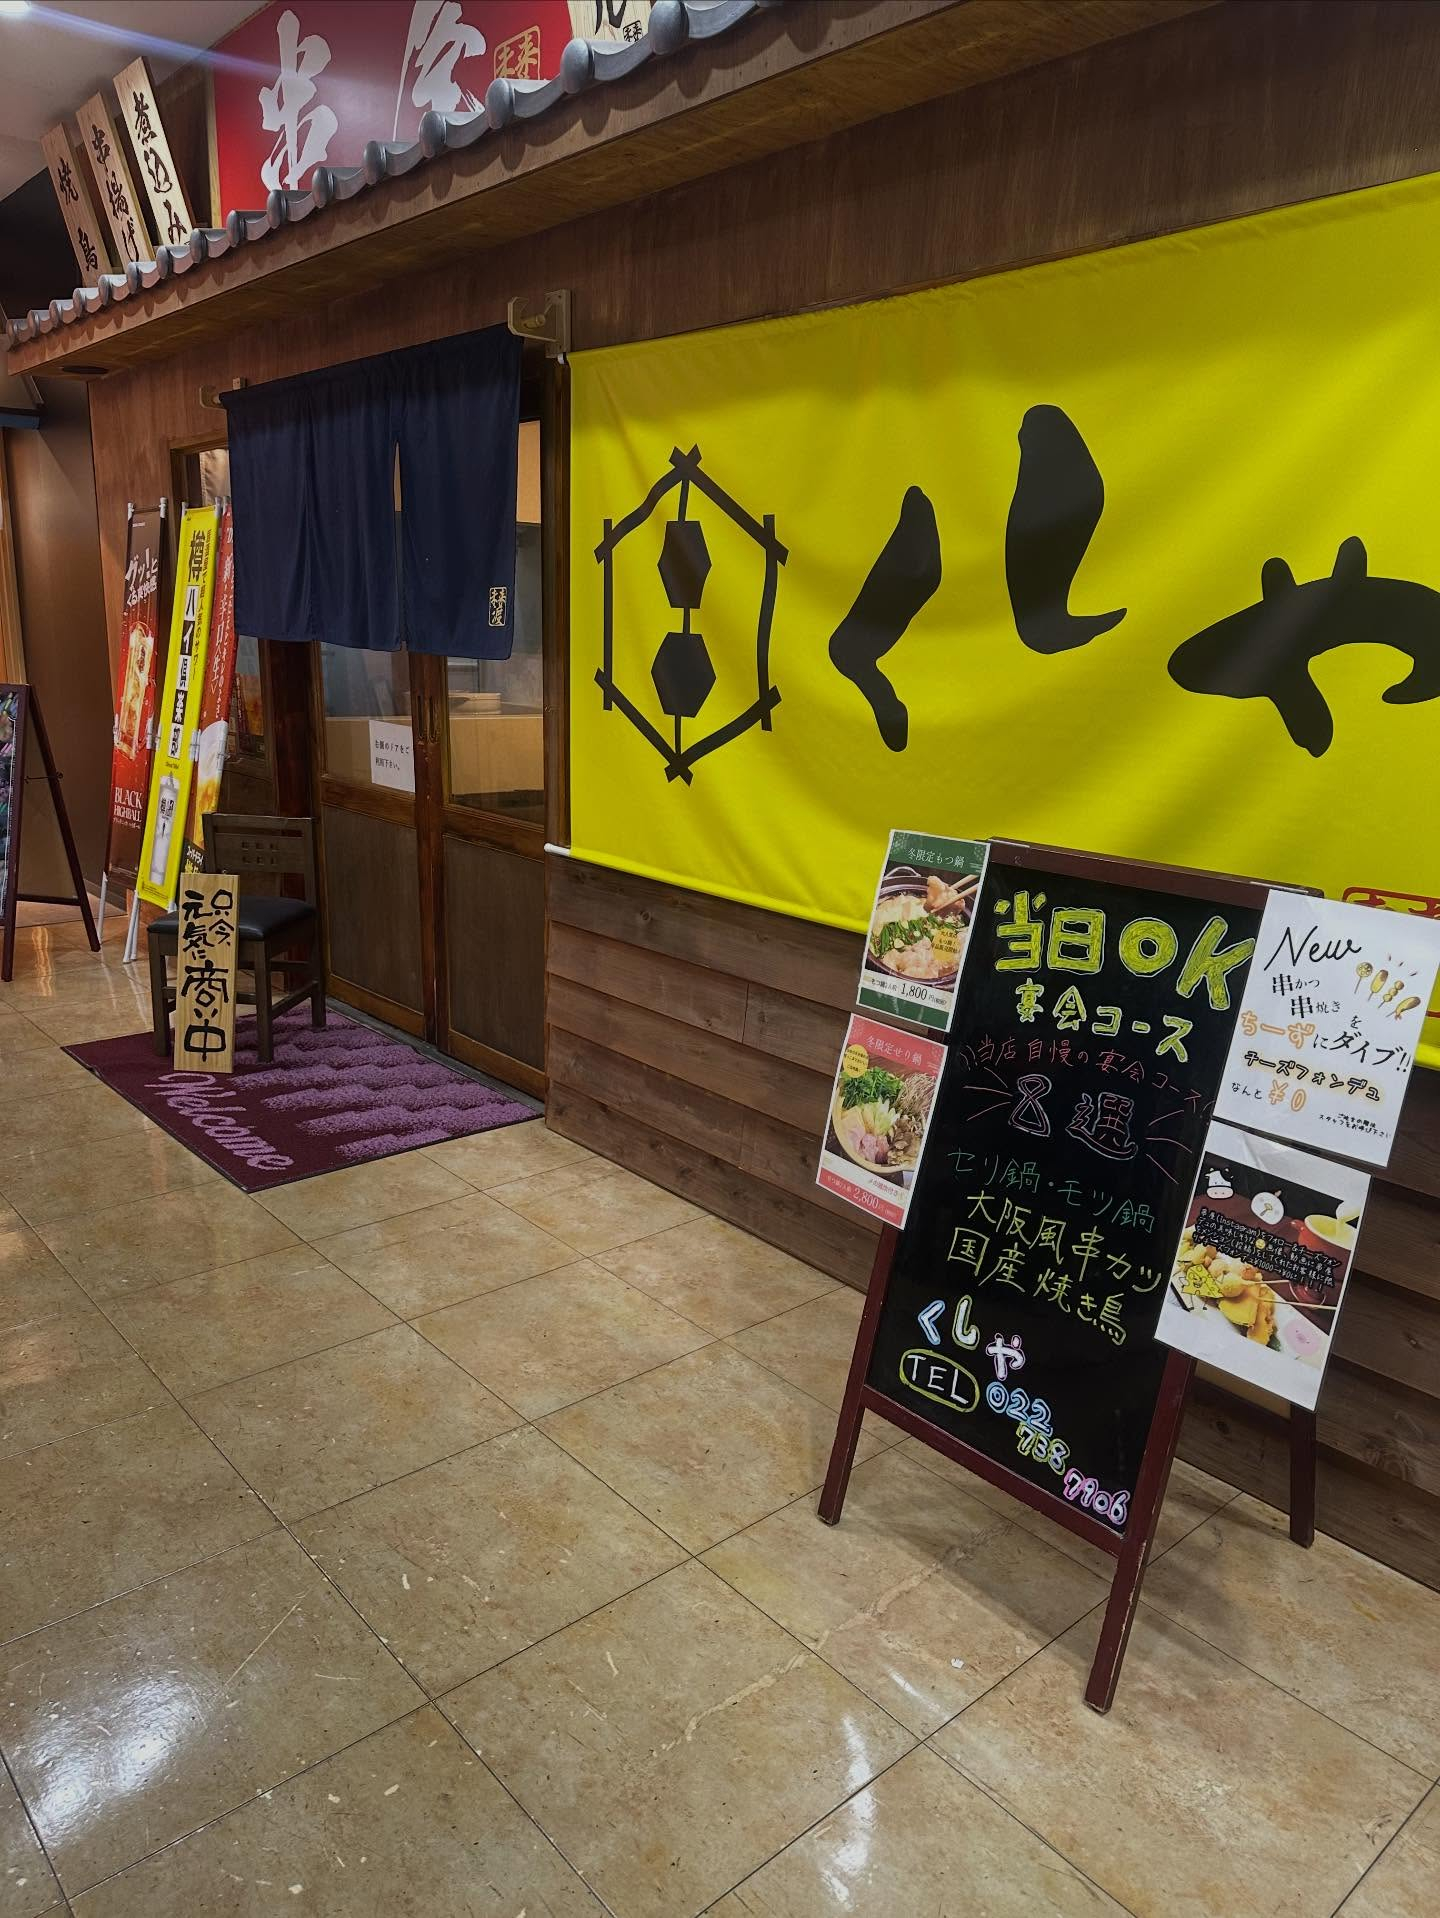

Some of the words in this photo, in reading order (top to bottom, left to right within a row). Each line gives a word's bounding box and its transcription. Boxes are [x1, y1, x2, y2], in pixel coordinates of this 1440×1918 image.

[829, 404, 1440, 757] くしや
[113, 804, 142, 822] HIGHBALL
[114, 787, 143, 810] BLACK
[908, 847, 965, 869] 冬限定もつ鍋
[180, 889, 230, 1062] 元気に商い中
[1264, 925, 1362, 971] New
[901, 983, 928, 1001] 1,800
[1272, 973, 1321, 996] 串かつ
[1290, 995, 1342, 1018] 串焼き
[1015, 978, 1193, 1063] 宴会コース
[866, 1035, 922, 1066] 冬限定せり鍋
[976, 1034, 1202, 1112] 当店自慢の宴会コース
[1244, 1050, 1381, 1102] チーズフォンデュ
[144, 1072, 295, 1171] Welcome
[853, 1187, 879, 1209] 2,800
[947, 1148, 1156, 1233] セリ鍋・モツ鍋
[967, 1190, 1163, 1292] 大阪風串カツ
[947, 1227, 1127, 1346] 国産焼き鳥
[917, 1294, 1026, 1381] くしや
[907, 1354, 969, 1404] TEL
[985, 1381, 1053, 1438] 022
[1015, 1421, 1071, 1476] 738
[1062, 1467, 1131, 1525] 7906
